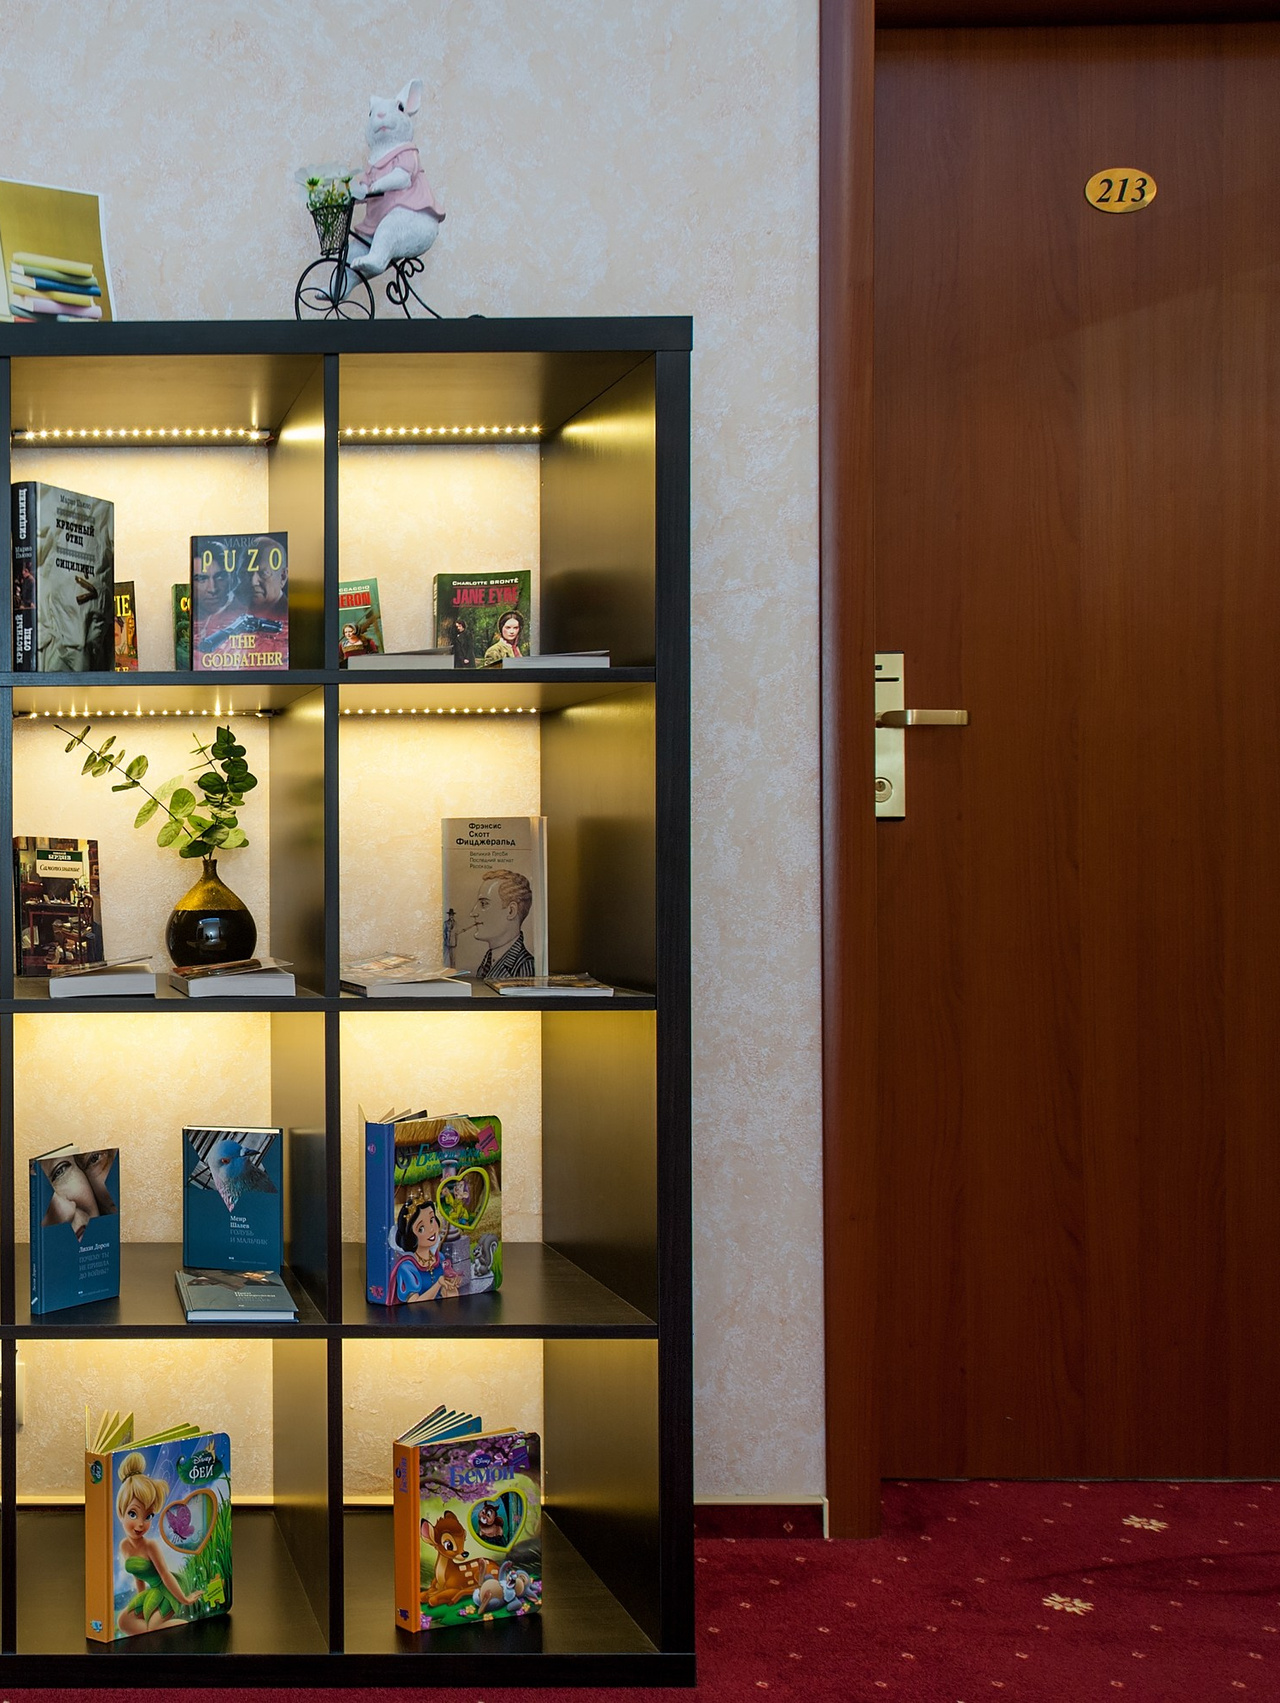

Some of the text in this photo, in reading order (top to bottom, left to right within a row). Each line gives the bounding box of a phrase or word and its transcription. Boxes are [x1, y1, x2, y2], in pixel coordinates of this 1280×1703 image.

[1096, 178, 1148, 203] 213
[19, 488, 27, 540] СИЦИЛИЕЦ
[55, 518, 95, 537] КРЕСТНЫЙ
[65, 532, 84, 548] ОТЕЦ
[223, 537, 259, 548] MARIO
[55, 558, 95, 577] СИЦИЛИЕЦ
[202, 547, 282, 573] PUZO
[452, 587, 485, 605] JANE
[488, 586, 519, 603] EYRE
[15, 614, 23, 664] КРЕСТНЫЙ
[24, 627, 33, 652] ОТЕЦ
[229, 635, 256, 649] THE
[202, 651, 284, 668] GODFATHER
[455, 838, 516, 846] Фицджеральд
[441, 1133, 458, 1143] Disney
[189, 1464, 214, 1484] ФЕИ
[448, 1462, 516, 1488] Бемби
